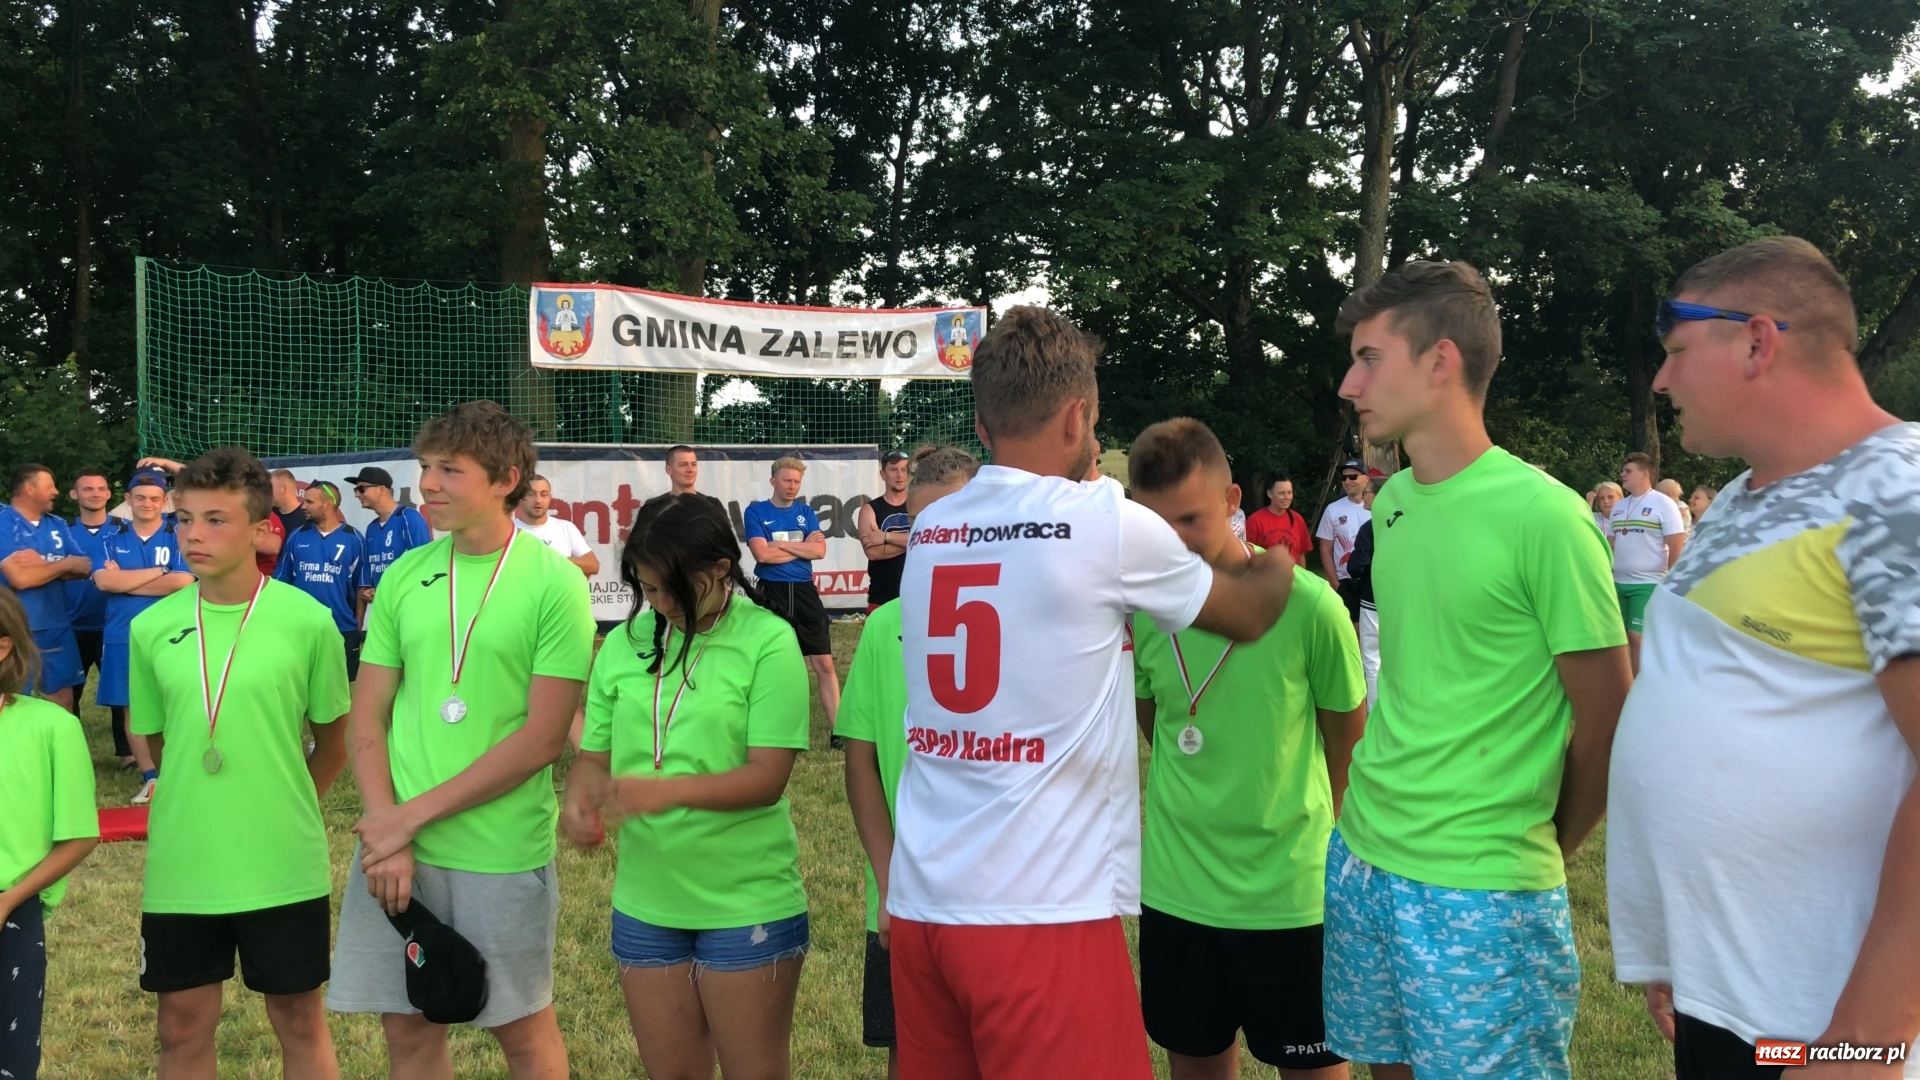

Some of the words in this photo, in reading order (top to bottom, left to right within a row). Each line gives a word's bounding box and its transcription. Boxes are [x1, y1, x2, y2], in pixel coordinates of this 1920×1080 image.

[612, 314, 746, 355] GMINA
[759, 328, 918, 359] ZALEWO
[50, 530, 63, 549] 5
[385, 530, 393, 547] 8
[154, 546, 170, 566] 10
[333, 543, 345, 561] 7
[299, 561, 319, 572] Firma
[304, 572, 334, 583] Pientka
[927, 562, 1002, 715] 5
